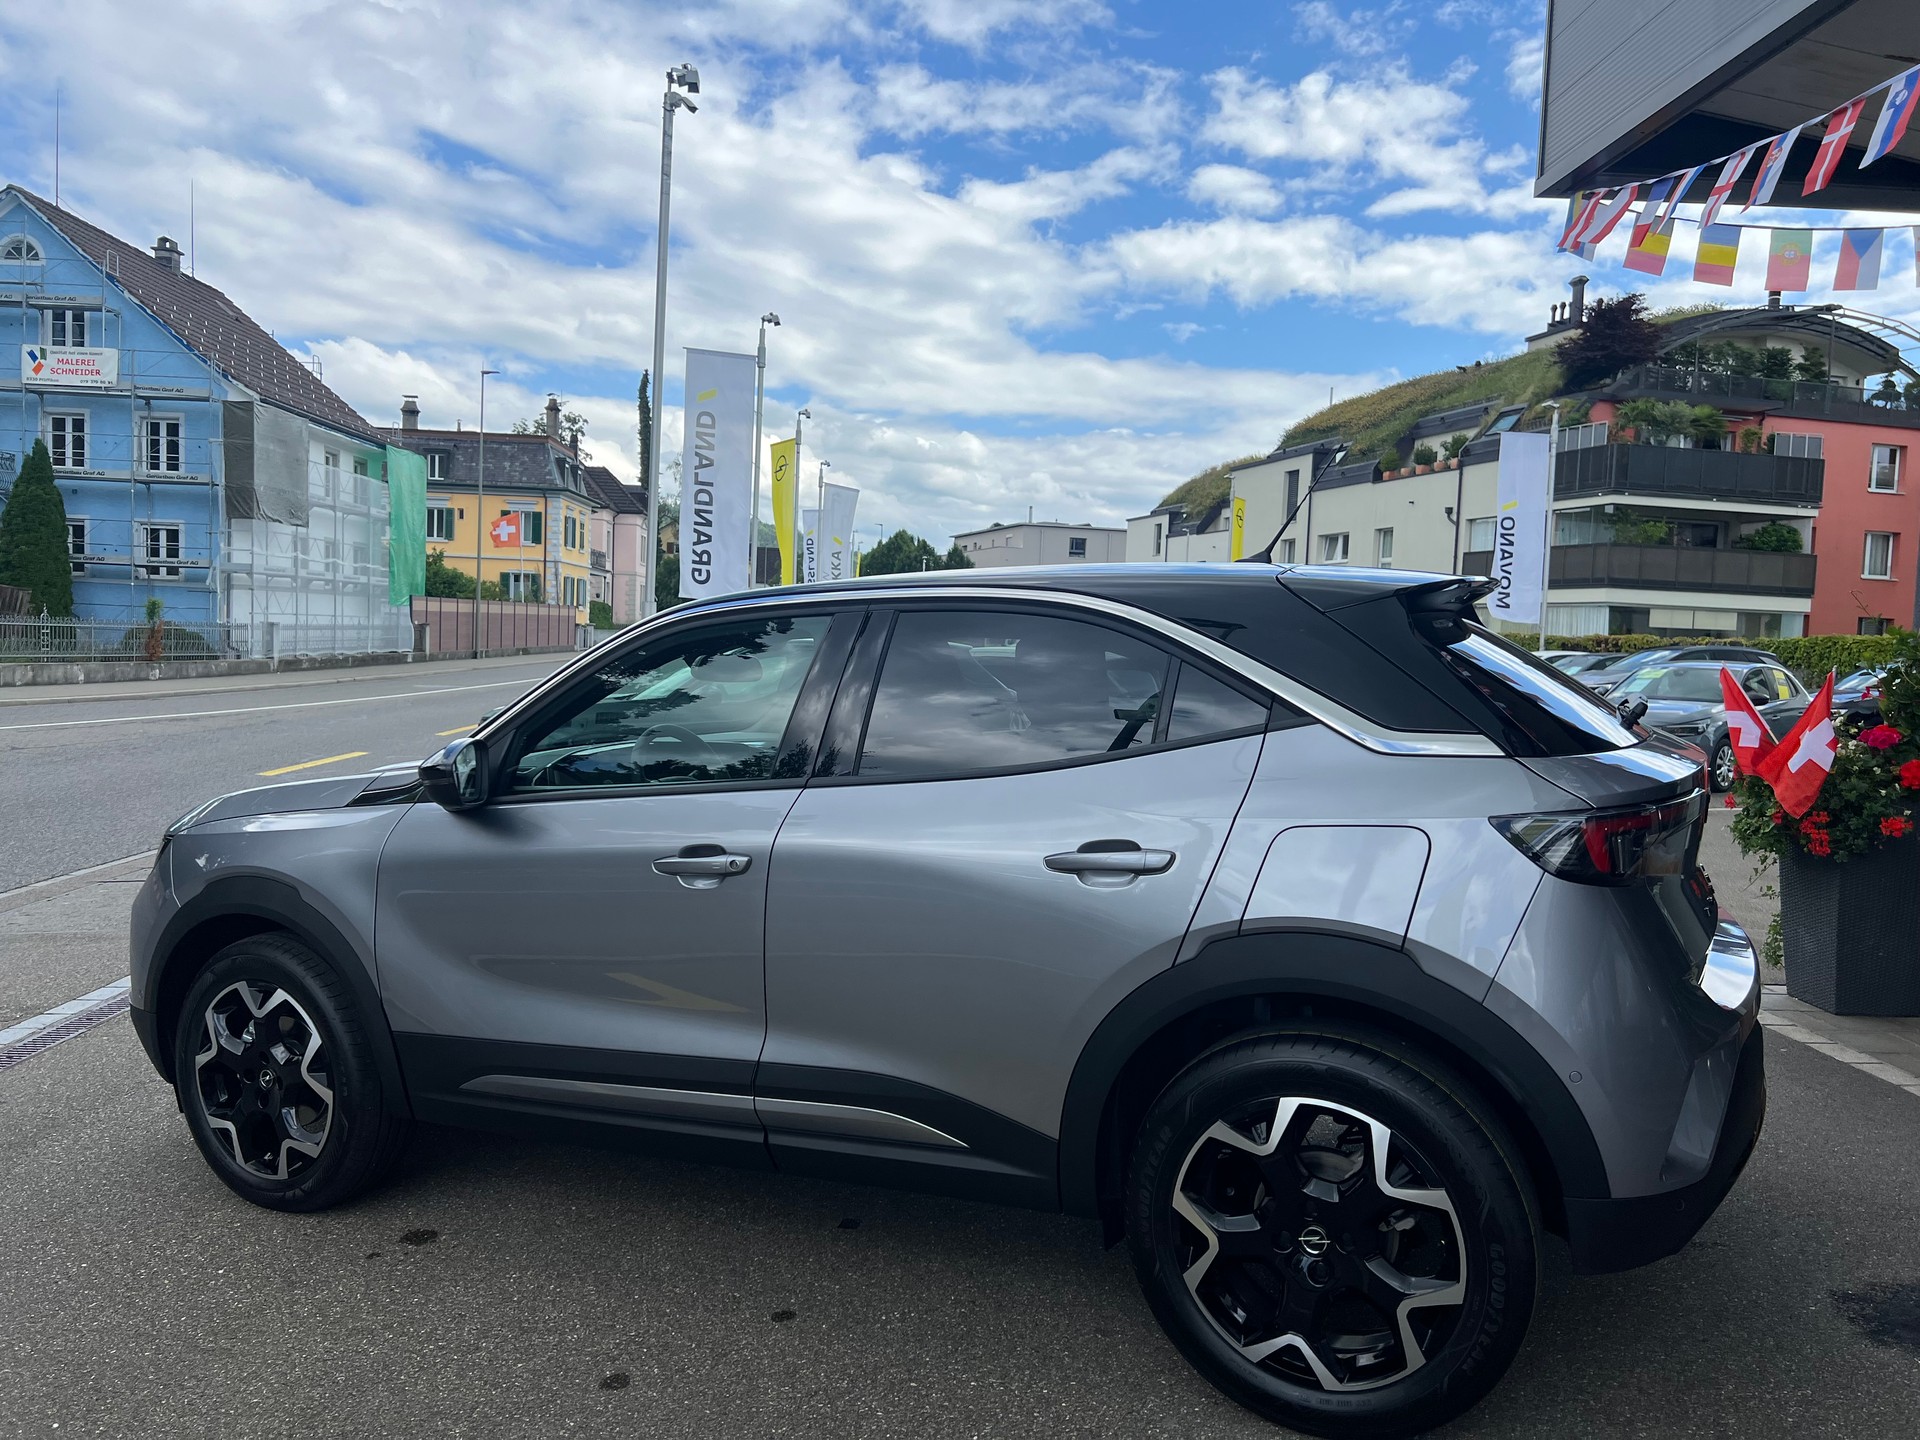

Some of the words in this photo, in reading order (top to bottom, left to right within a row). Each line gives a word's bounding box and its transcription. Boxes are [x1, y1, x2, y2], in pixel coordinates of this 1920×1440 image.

[57, 358, 96, 366] MALEREI
[50, 367, 101, 376] SCHNEIDER
[831, 550, 842, 580] KKA
